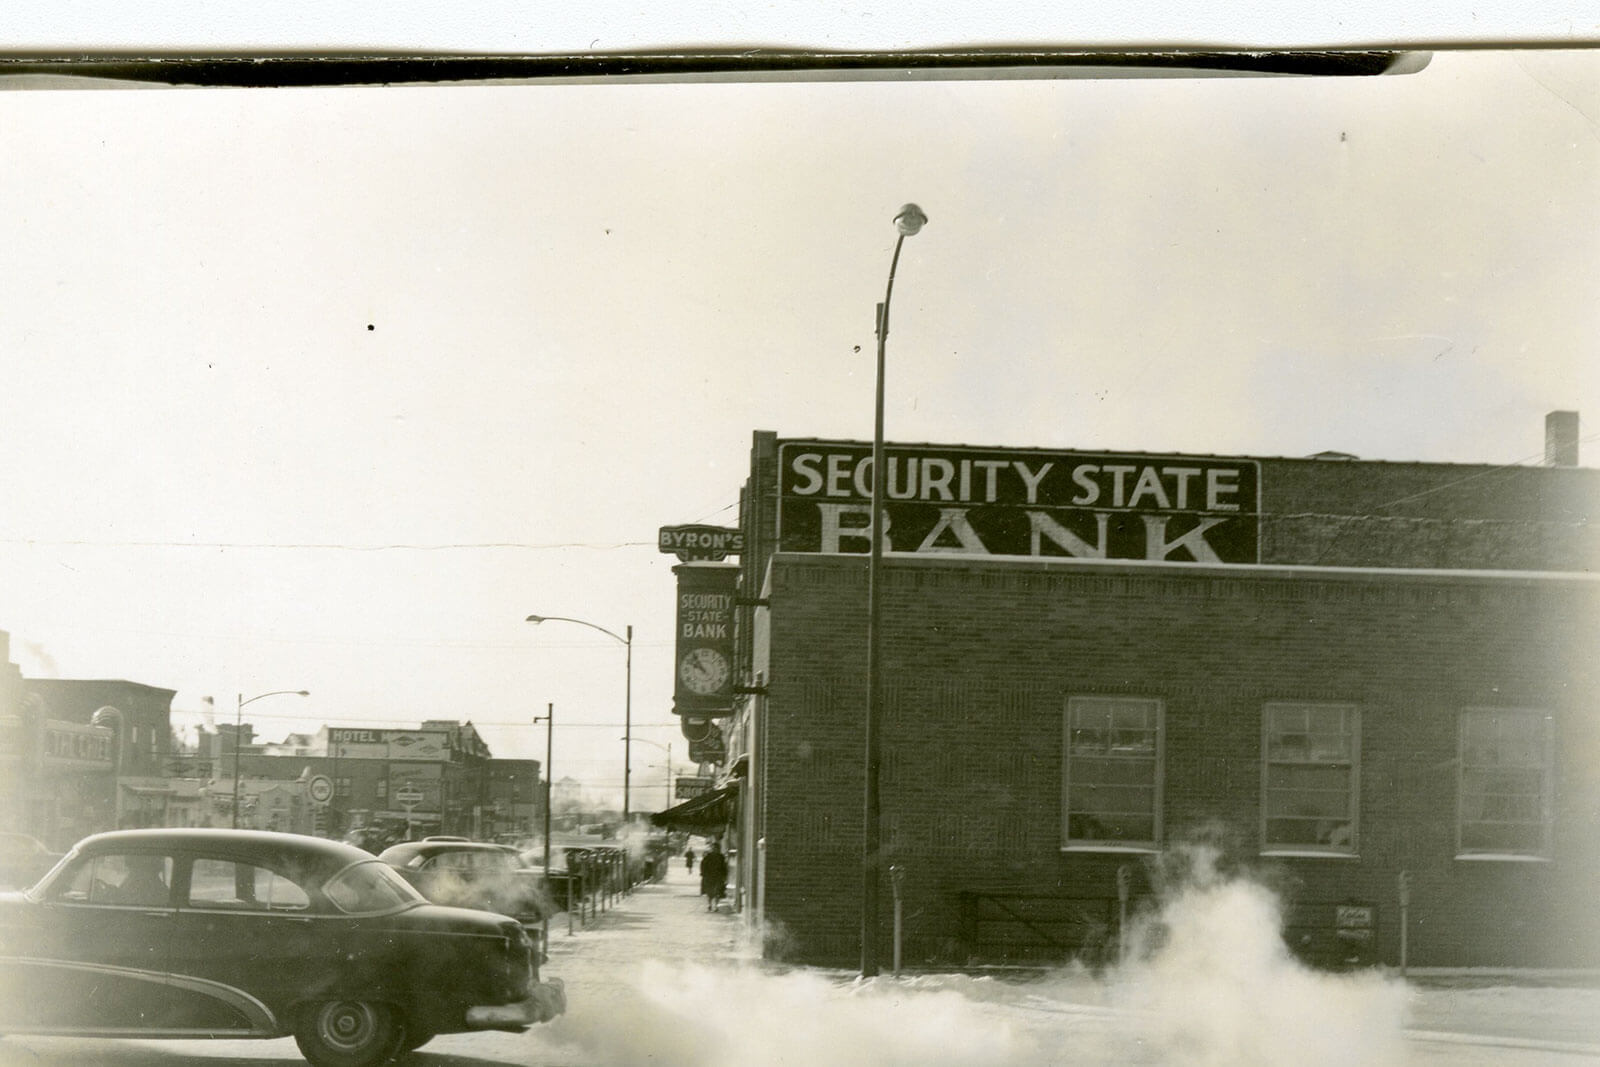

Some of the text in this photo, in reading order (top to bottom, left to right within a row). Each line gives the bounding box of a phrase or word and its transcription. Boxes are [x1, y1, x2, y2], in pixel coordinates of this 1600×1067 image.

[791, 452, 1241, 511] SECURITY STATE
[660, 532, 743, 549] BYRON'S
[818, 503, 1230, 562] BANK
[681, 594, 732, 609] SECURITY
[683, 623, 727, 640] BANK
[333, 730, 376, 743] HOTEL
